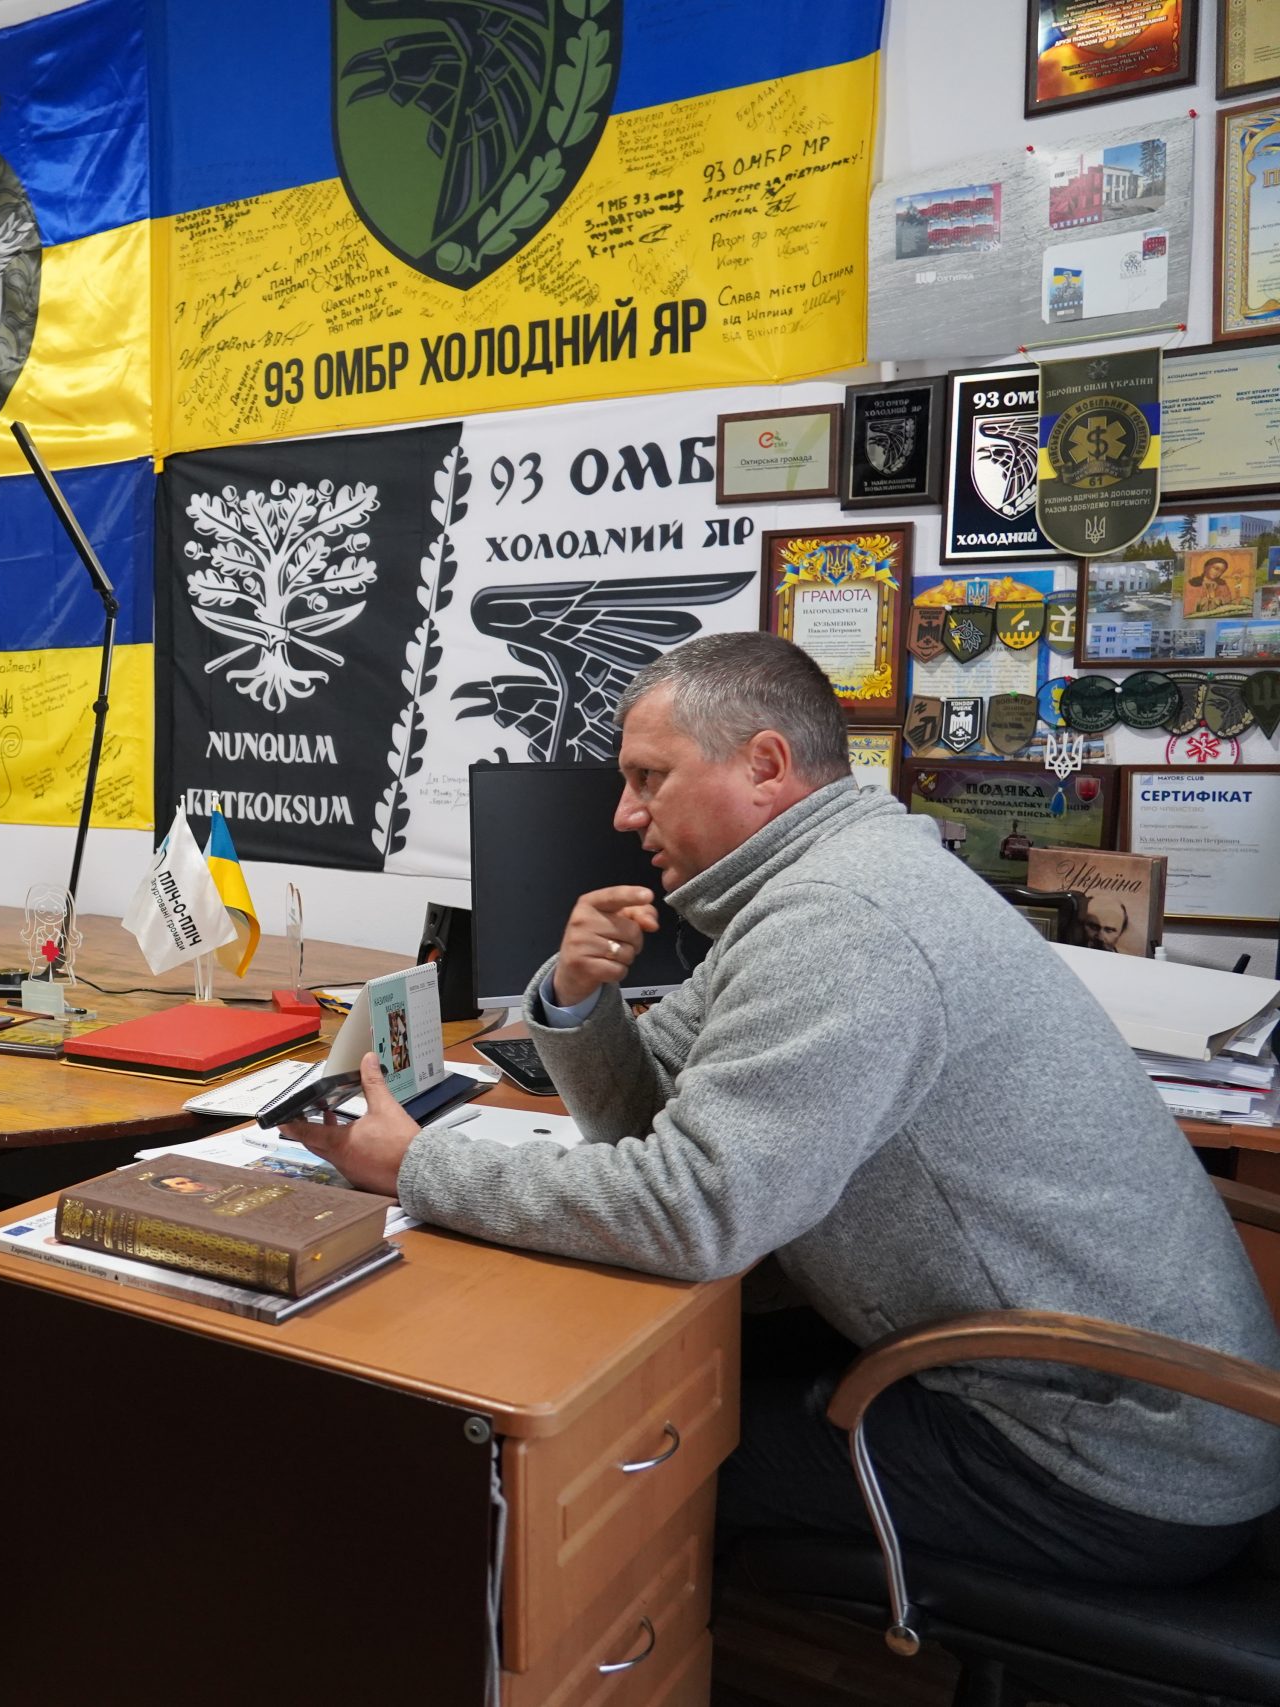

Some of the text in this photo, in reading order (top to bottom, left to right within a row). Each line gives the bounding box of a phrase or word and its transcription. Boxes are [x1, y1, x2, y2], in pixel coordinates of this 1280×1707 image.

[703, 159, 726, 184] 93
[733, 144, 792, 176] ОМБР
[264, 358, 304, 408] 93
[313, 341, 410, 401] ОМБР
[419, 297, 638, 387] ХОЛОДНИЙ
[649, 298, 708, 357] ЯР
[1083, 381, 1108, 392] СИЛИ
[1109, 377, 1154, 390] УКРАЇНИ
[972, 390, 1040, 410] 93 ОМ
[740, 454, 813, 466] Охтирська громада
[490, 451, 544, 506] 93
[1089, 476, 1104, 487] 61
[1099, 490, 1109, 498] ЗА
[1110, 488, 1152, 498] ДОПОМОГУ!
[1044, 498, 1151, 514] РАЗОМ ЗДОБУДЕМО ПЕРЕМОГУ!
[485, 516, 755, 563] ХОЛОДНИЙ ЯР
[956, 528, 1038, 546] ХОЛОДНИЙ
[801, 588, 872, 603] ГРАМОТА
[205, 731, 339, 765] NUNQUAM
[966, 783, 1045, 798] ПОДЯКА
[1140, 790, 1253, 803] СЕРТИФІКАТ
[964, 807, 1016, 817] ДОПОМОГУ
[980, 799, 1043, 809] ГРОМАДСЬКУ
[1055, 859, 1142, 894] Україна
[158, 870, 203, 947] ПЛІЧ-О-ПЛІЧ
